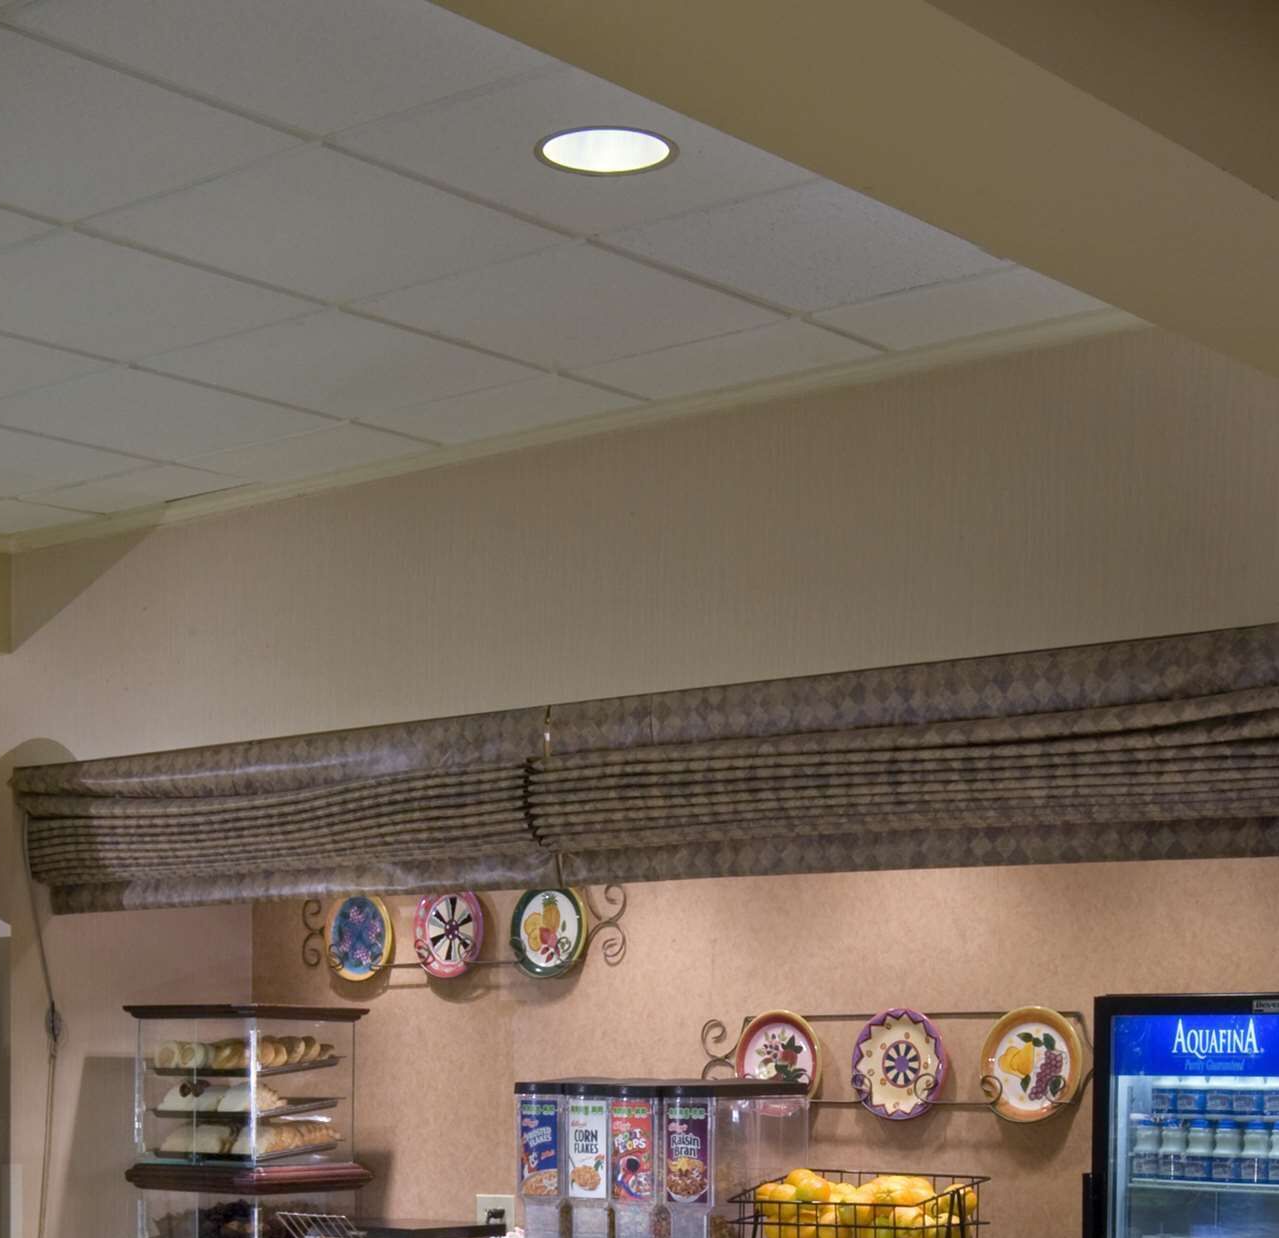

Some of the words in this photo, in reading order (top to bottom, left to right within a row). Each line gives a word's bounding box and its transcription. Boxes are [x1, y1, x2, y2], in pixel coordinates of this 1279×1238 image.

[1172, 1017, 1260, 1060] AQUAFINA
[574, 1129, 598, 1143] CORN
[671, 1133, 700, 1147] Raisin
[574, 1143, 599, 1154] FLAKES
[673, 1146, 697, 1158] Bran
